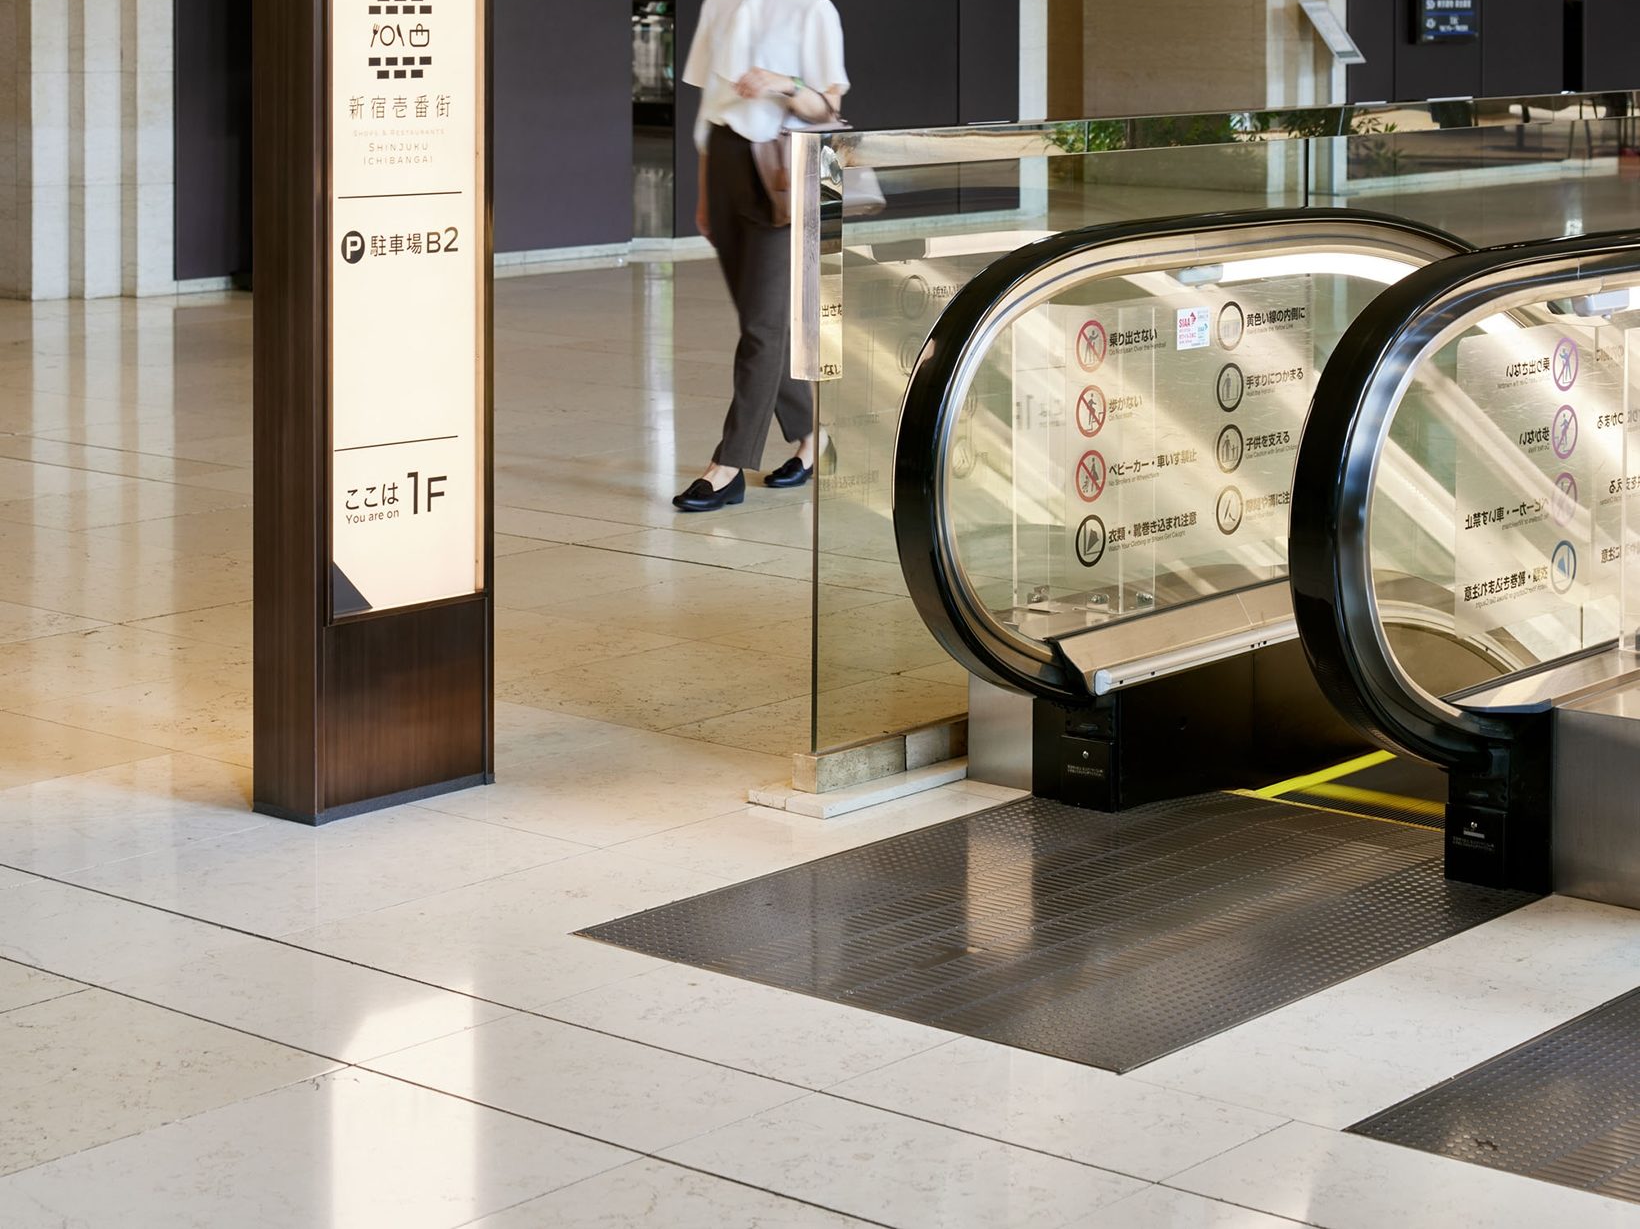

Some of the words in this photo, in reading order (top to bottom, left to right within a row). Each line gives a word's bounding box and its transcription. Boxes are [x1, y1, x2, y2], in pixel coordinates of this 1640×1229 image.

[349, 95, 451, 120] 新宿壱番街
[1247, 306, 1306, 327] 黄色い線の内側に
[1109, 328, 1158, 347] 乗り出さない
[1246, 368, 1303, 389] 手すりにつかまる
[1109, 395, 1142, 413] 歩かない
[1246, 431, 1290, 451] 子供を支える
[1109, 448, 1197, 475] ベビーカー・車いす禁止
[346, 482, 399, 510] ここは
[407, 471, 447, 515] 1F
[346, 514, 366, 524] You
[368, 511, 384, 522] are
[387, 510, 399, 519] on
